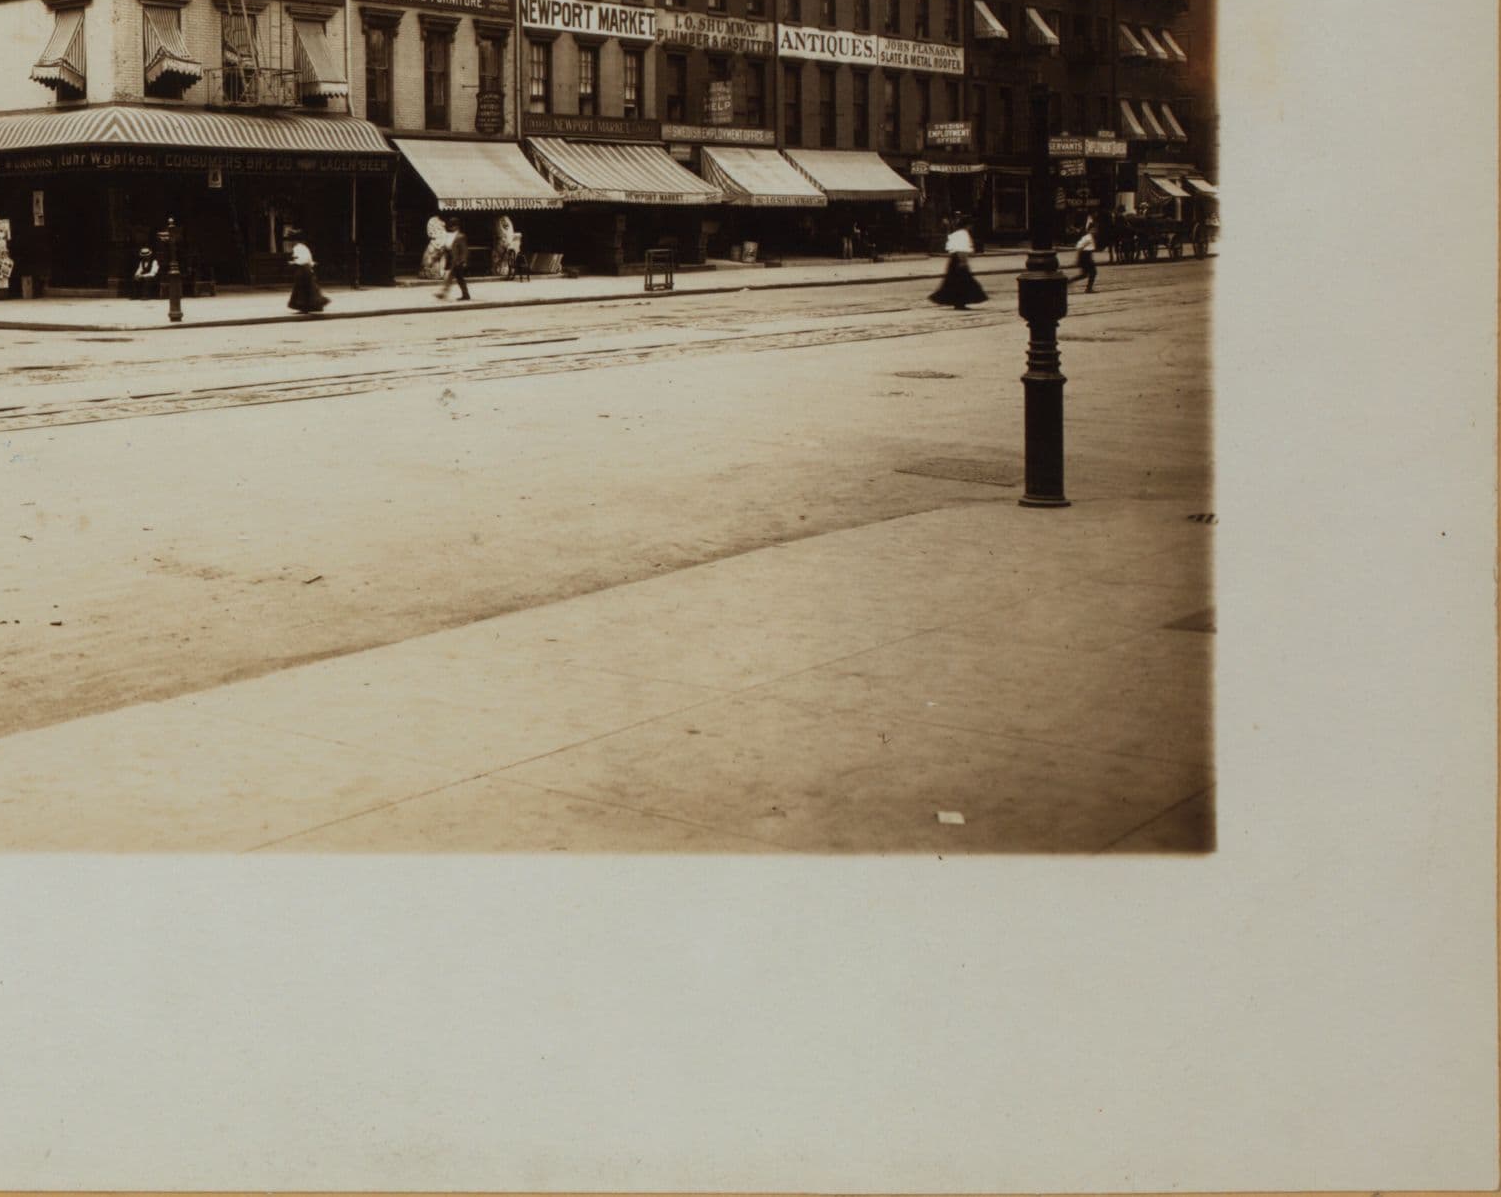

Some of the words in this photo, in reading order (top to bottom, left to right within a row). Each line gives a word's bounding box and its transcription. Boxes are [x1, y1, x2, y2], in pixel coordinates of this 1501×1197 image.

[657, 28, 710, 48] PLUMBER
[713, 35, 719, 48] &
[780, 29, 876, 59] ANTIQUES.
[885, 38, 910, 52] JOHN
[880, 51, 902, 63] SLATE
[904, 53, 909, 64] &
[911, 54, 932, 67] METAL
